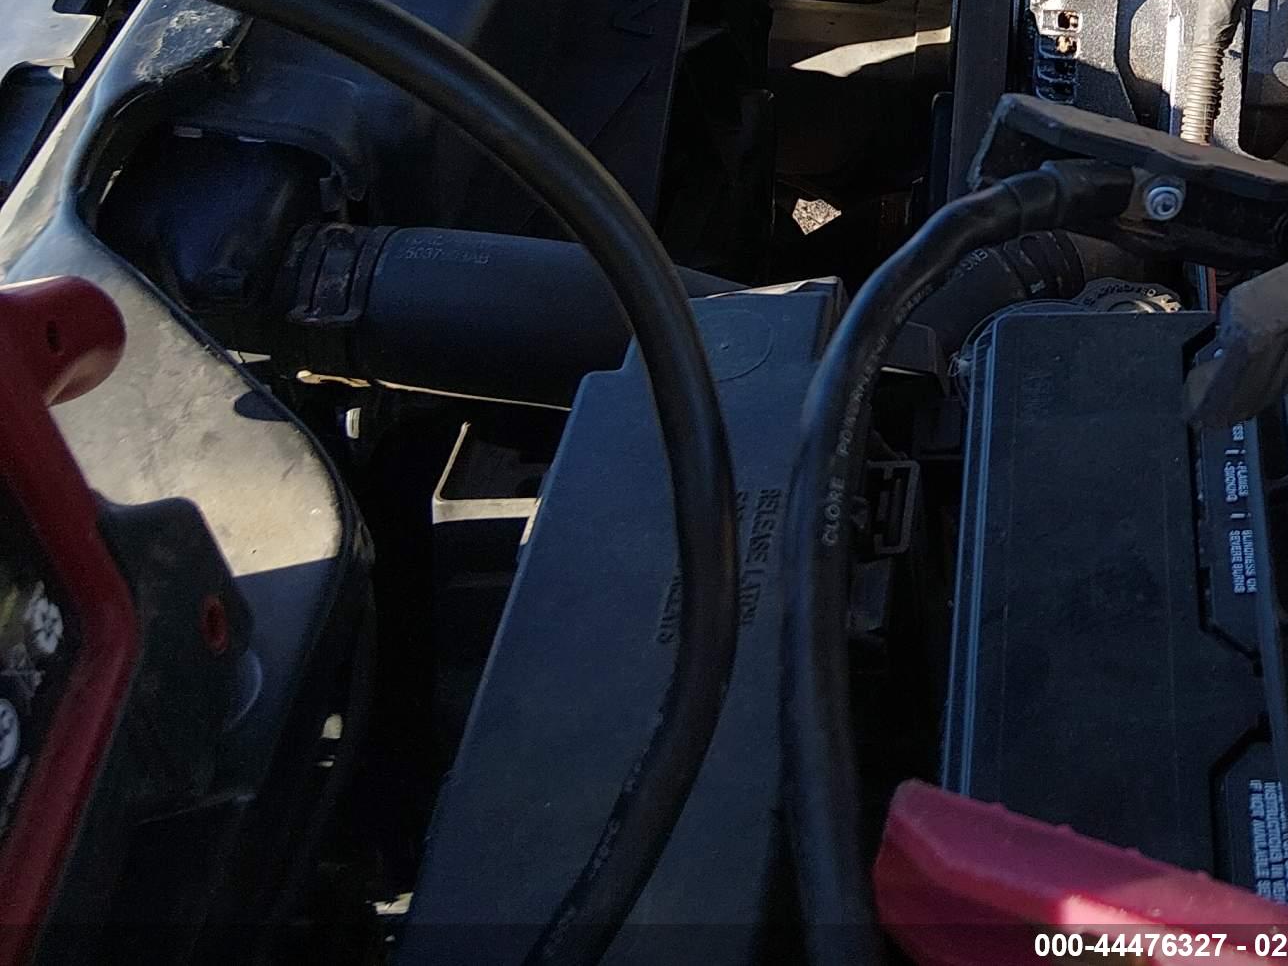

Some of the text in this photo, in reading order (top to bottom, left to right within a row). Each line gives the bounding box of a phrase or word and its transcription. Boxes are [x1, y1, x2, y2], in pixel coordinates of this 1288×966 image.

[821, 476, 846, 547] CLORE
[1229, 529, 1246, 594] SEVERE BURNS
[1241, 529, 1257, 577] BLINDNESS
[1249, 778, 1263, 791] IF
[1250, 792, 1265, 817] NOT
[1252, 819, 1271, 878] AVAILABLE
[1263, 781, 1284, 863] INSTRUCTIONS
